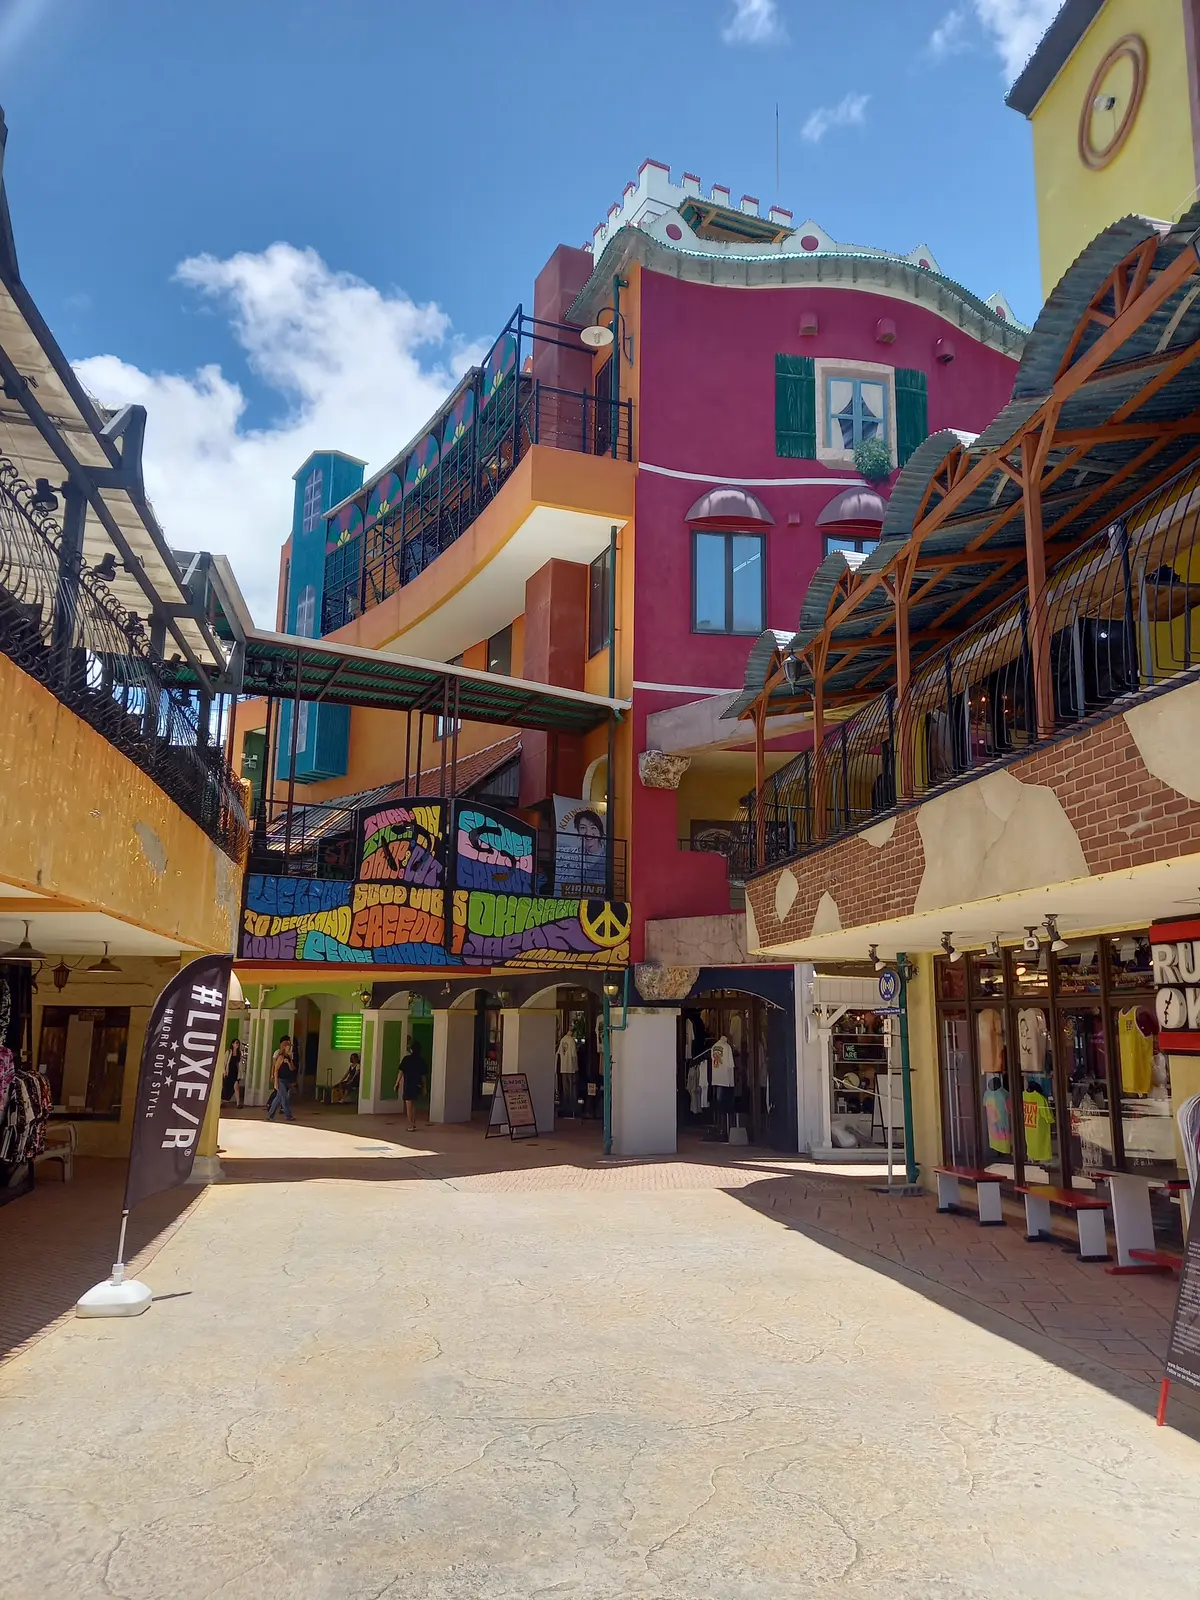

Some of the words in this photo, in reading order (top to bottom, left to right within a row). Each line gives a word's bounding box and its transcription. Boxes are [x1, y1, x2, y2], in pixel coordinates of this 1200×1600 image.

[244, 909, 271, 937] TO
[353, 883, 408, 913] GOOD
[410, 887, 469, 926] VIBS
[468, 890, 580, 937] OKINAWA
[242, 932, 297, 958] LOVE
[303, 929, 375, 963] PEACE
[462, 917, 604, 966] JAPAN
[158, 1008, 175, 1049] #WORK
[153, 1054, 165, 1076] OUT
[145, 1081, 161, 1119] STYLE
